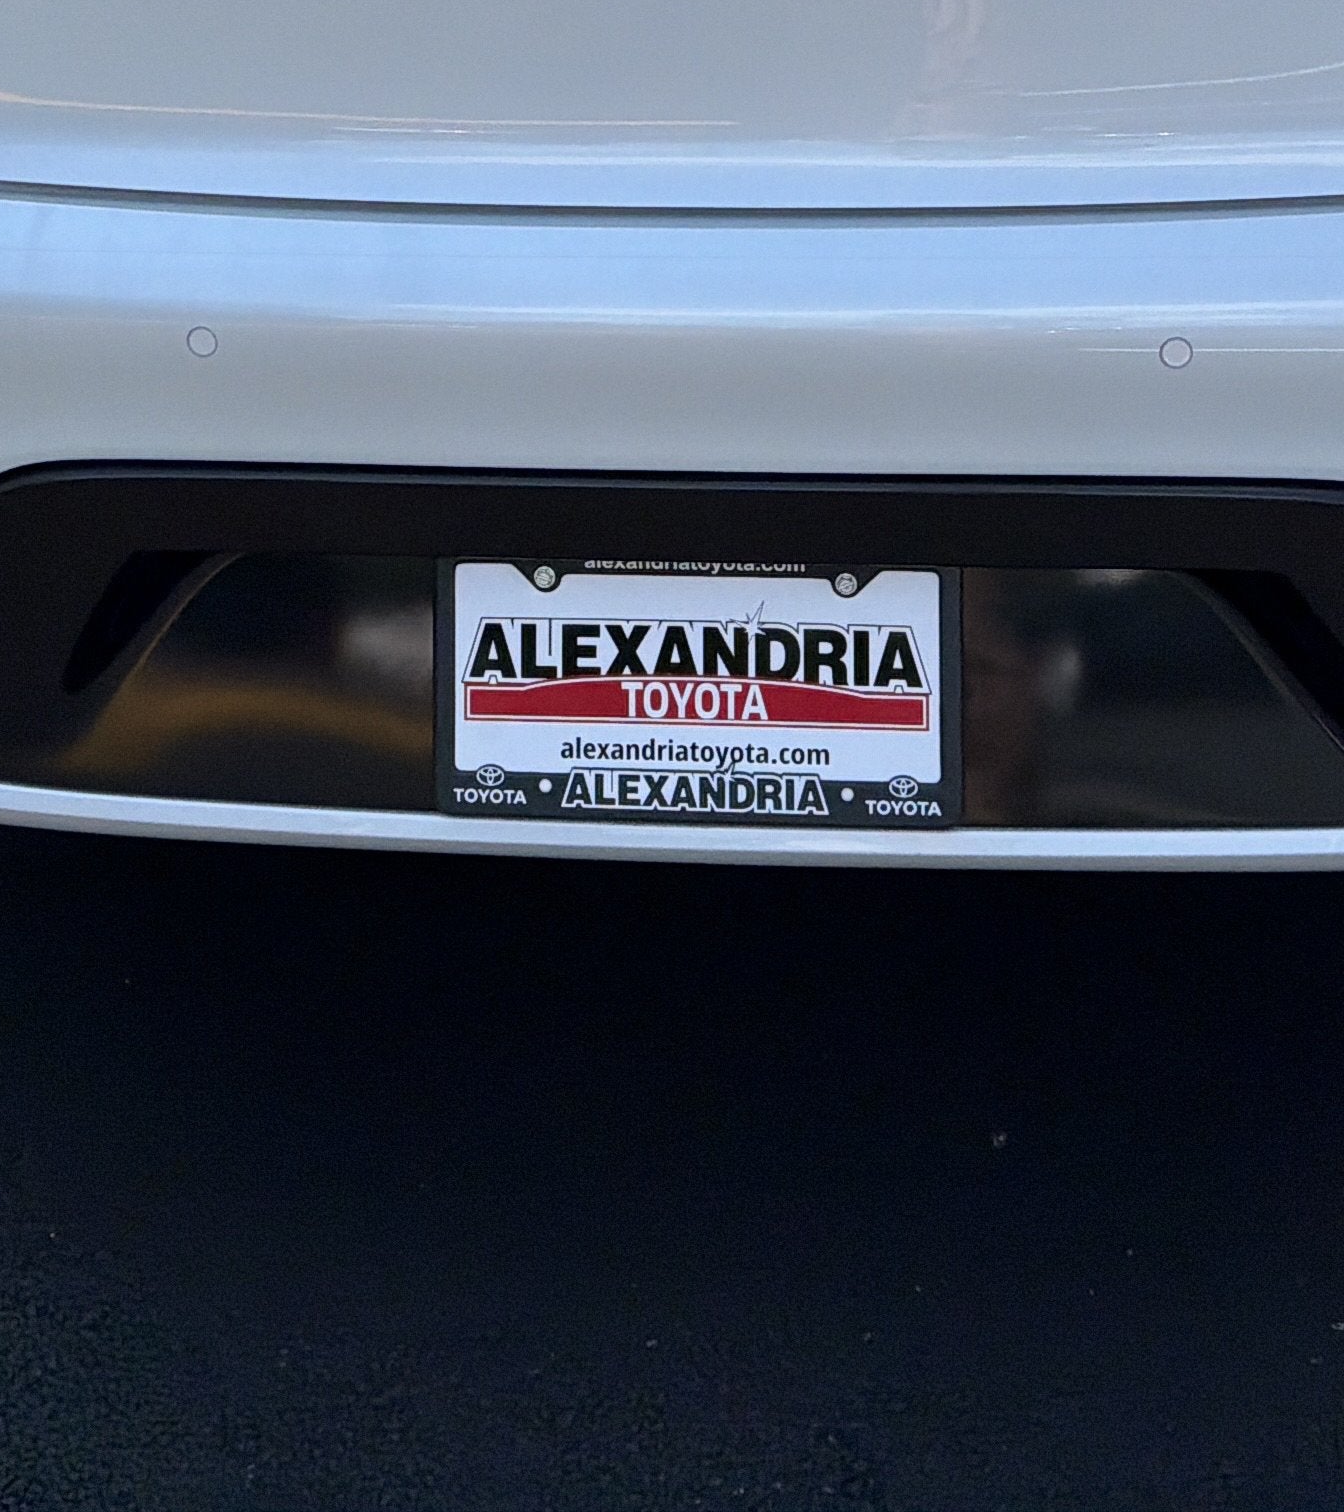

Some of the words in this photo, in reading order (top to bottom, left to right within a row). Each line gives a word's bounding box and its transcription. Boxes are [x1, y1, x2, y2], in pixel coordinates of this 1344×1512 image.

[467, 621, 925, 690] ALEXANDRIA
[620, 680, 770, 722] TOYOTA
[559, 737, 832, 769] alexandriatoyota.com
[453, 787, 528, 806] TOYOTA
[562, 769, 829, 816] ALEXANDRIA
[864, 798, 943, 818] TOYOTA
